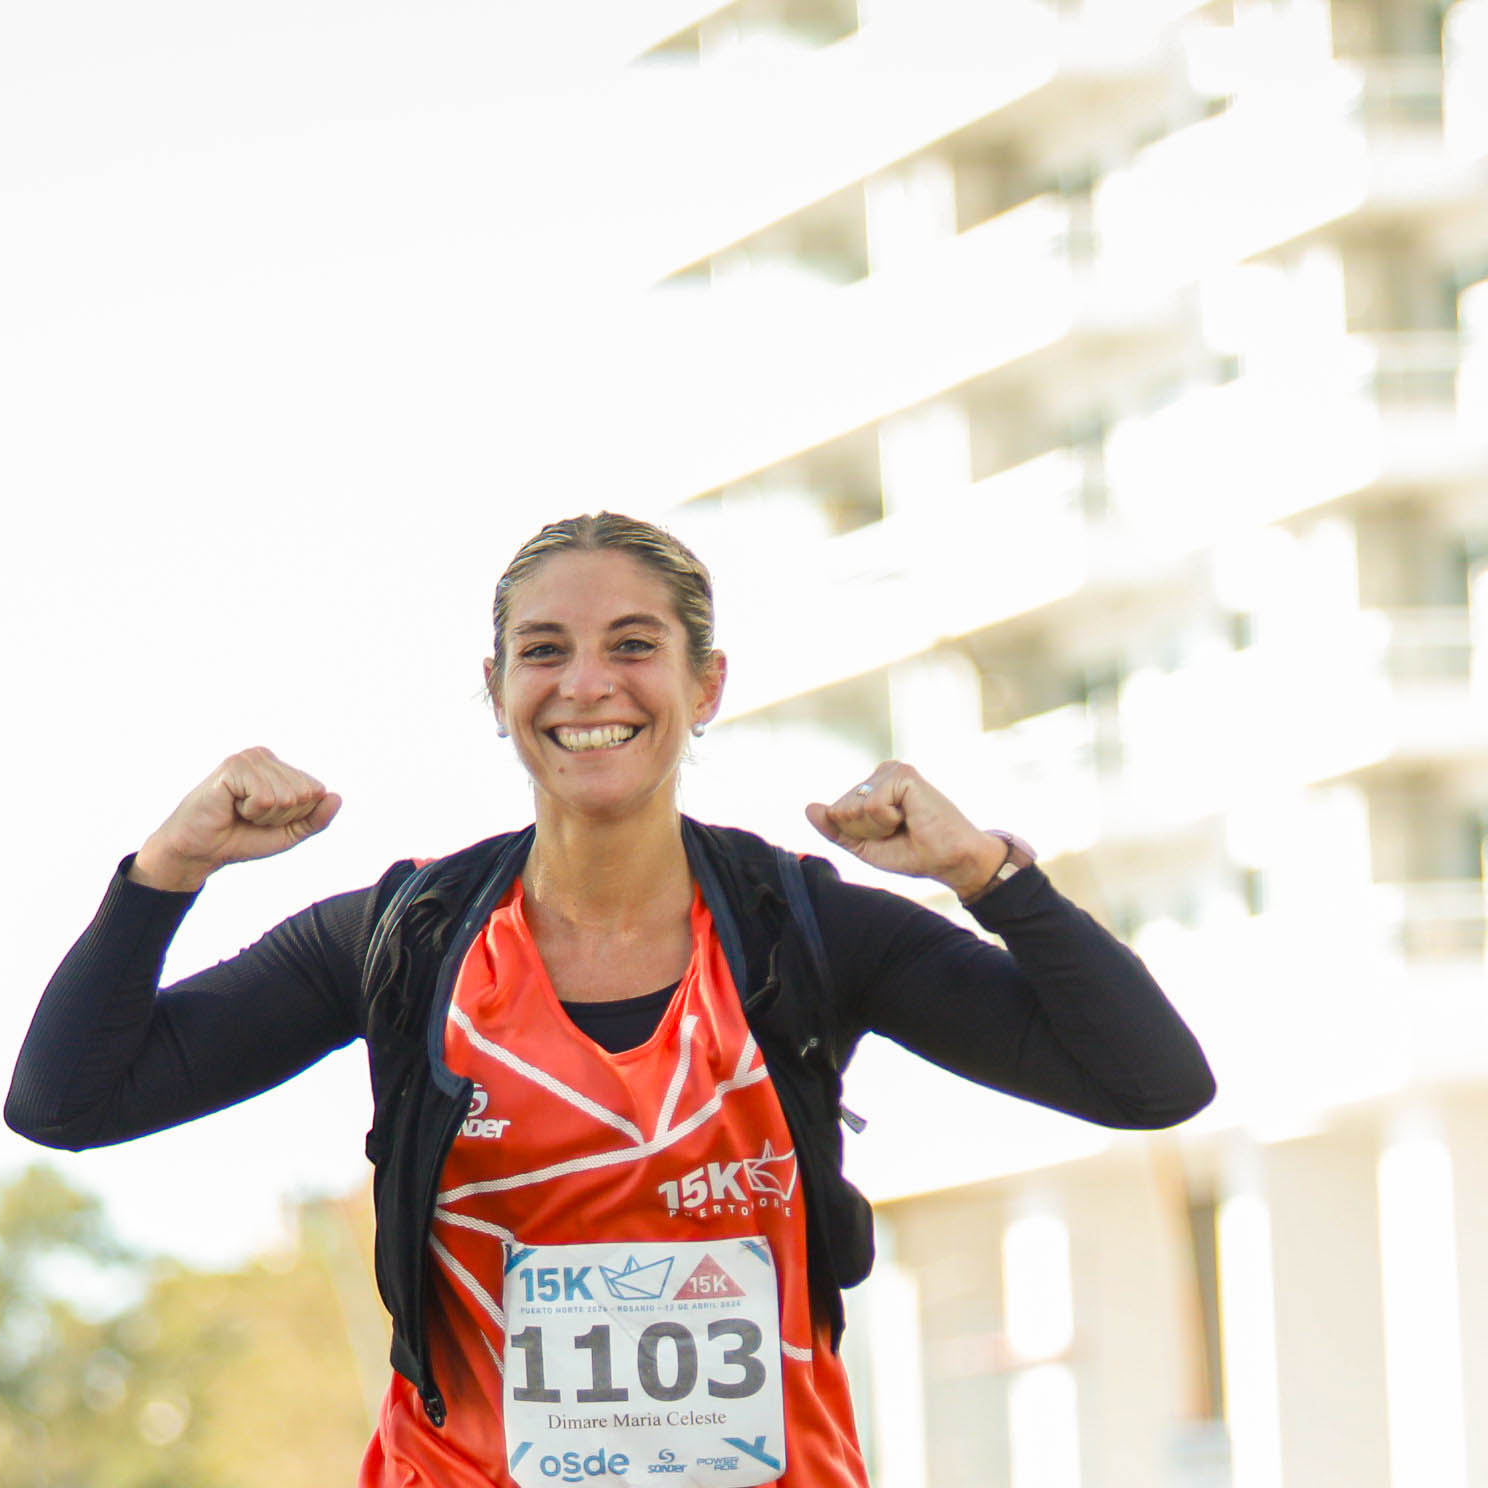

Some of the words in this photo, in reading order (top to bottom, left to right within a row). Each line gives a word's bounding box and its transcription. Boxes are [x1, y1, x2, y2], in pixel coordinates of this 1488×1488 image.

[658, 1162, 748, 1209] 15K
[520, 1267, 594, 1302] 15K
[689, 1275, 729, 1293] 15K
[520, 1306, 552, 1315] PUERTO
[555, 1305, 584, 1314] NORTE
[617, 1304, 655, 1312] ROSARIO
[692, 1302, 717, 1310] ABRIL
[510, 1318, 766, 1403] 1103
[548, 1414, 608, 1429] Dimare
[613, 1412, 661, 1428] Maria
[666, 1410, 727, 1426] Celeste
[540, 1448, 629, 1477] osde
